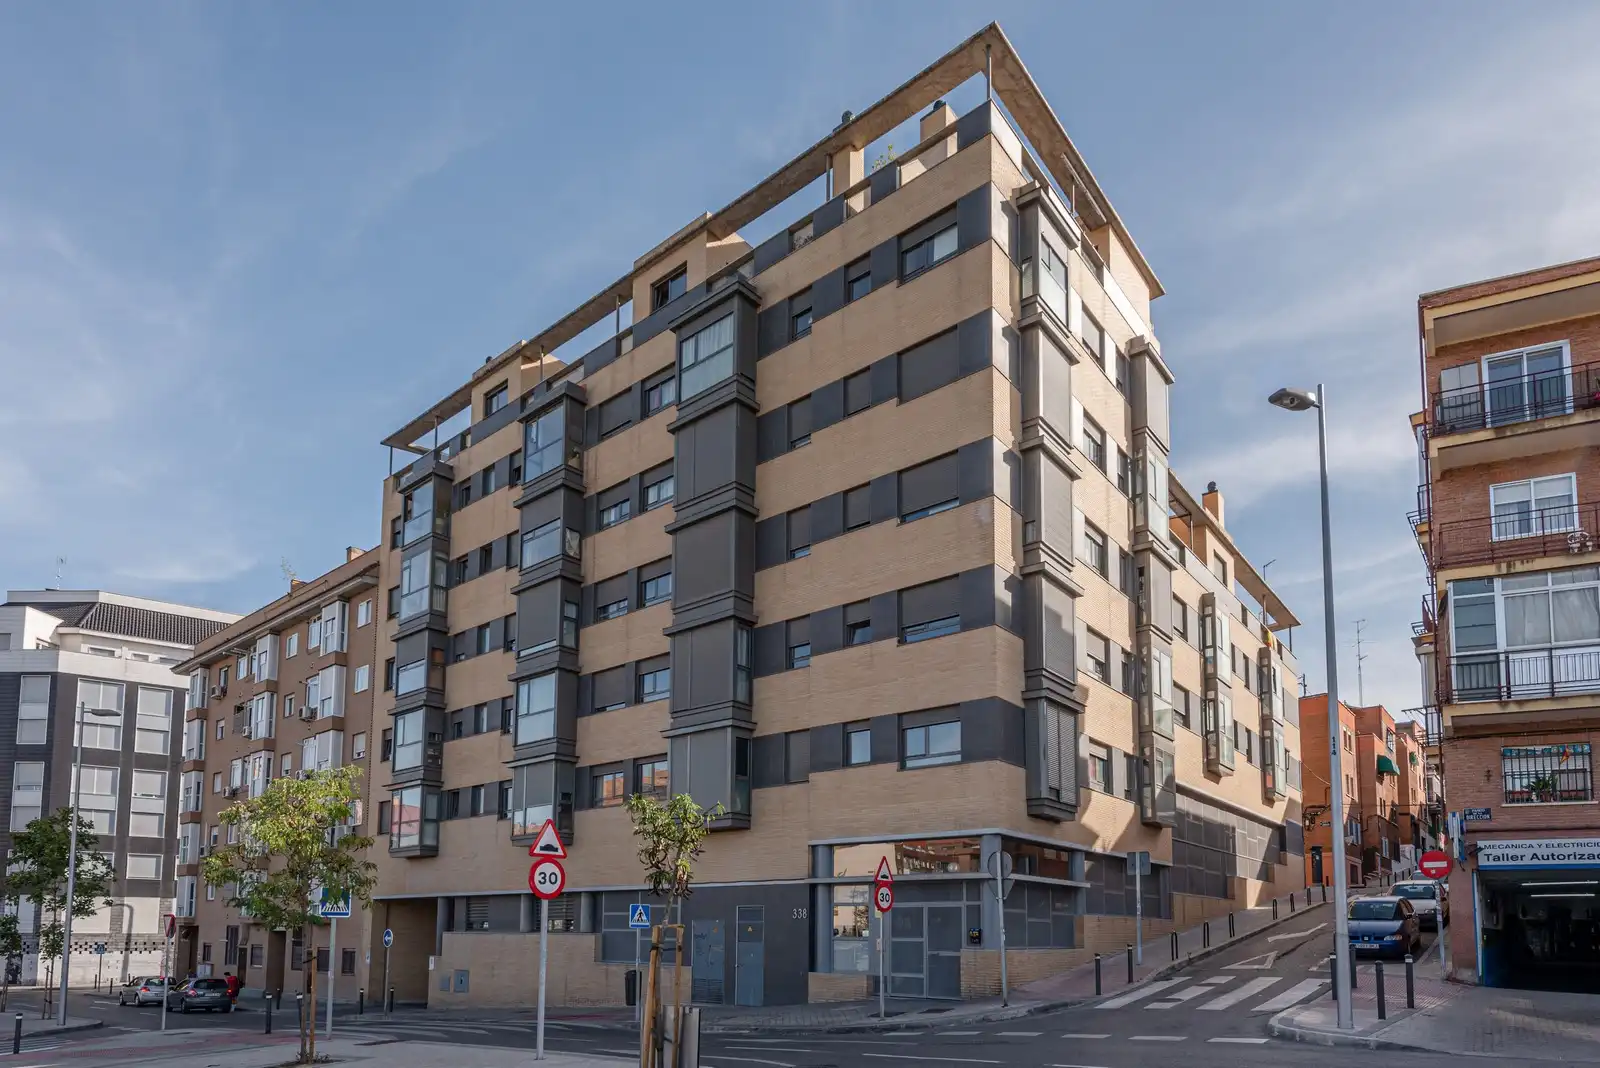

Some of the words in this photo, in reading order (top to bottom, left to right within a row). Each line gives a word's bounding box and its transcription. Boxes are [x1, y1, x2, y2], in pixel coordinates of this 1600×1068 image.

[1483, 853, 1526, 862] Taller
[538, 871, 558, 885] 30
[879, 892, 890, 903] 30
[792, 908, 808, 919] 338
